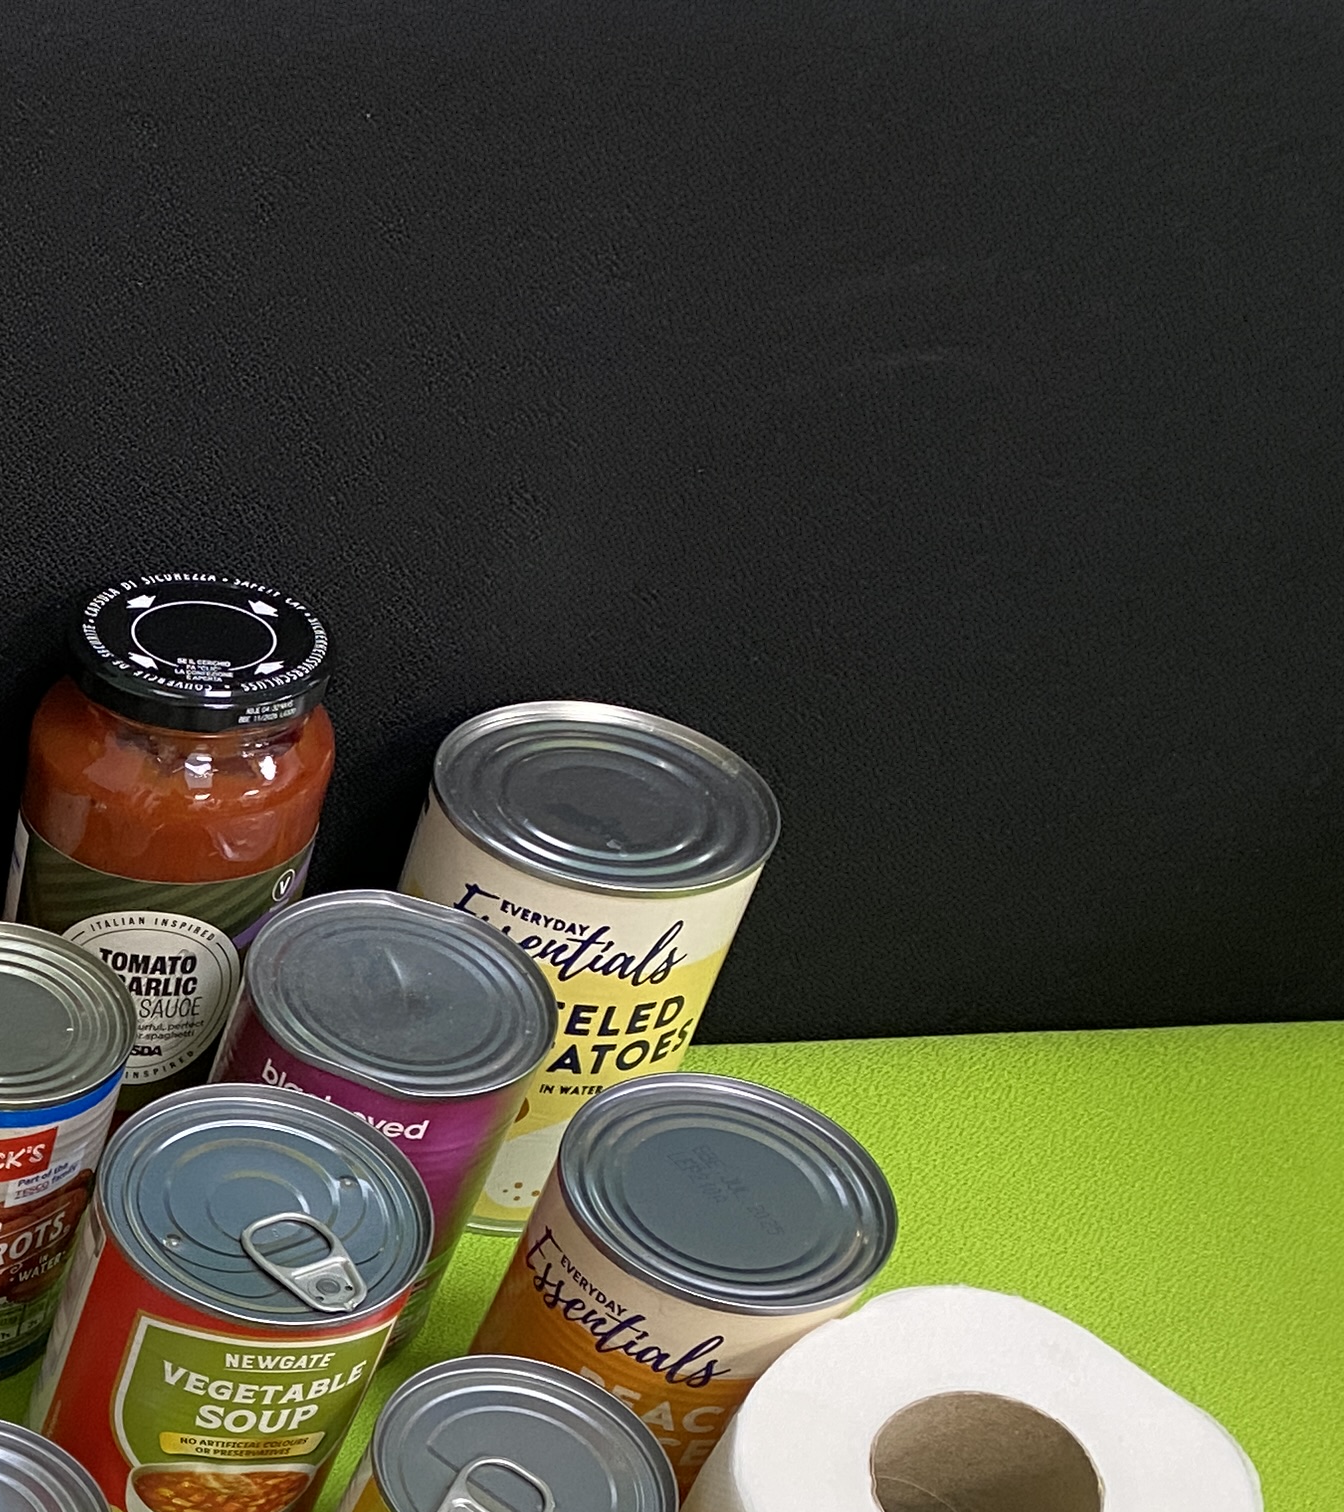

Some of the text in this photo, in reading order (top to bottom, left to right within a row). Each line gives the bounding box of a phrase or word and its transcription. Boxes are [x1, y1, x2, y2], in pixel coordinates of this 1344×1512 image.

[89, 917, 216, 942] ITALIAN INSPIRED
[500, 900, 590, 937] EVERYDAY
[100, 948, 197, 976] TOMATO
[139, 997, 202, 1018] SAUCE
[559, 1084, 603, 1096] WATER
[559, 1254, 628, 1316] EVERYDAY
[525, 1226, 732, 1389] Essentials
[224, 1352, 336, 1370] NEWGATE
[162, 1359, 368, 1405] VEGETABLE
[195, 1404, 319, 1434] SOUP
[180, 1437, 197, 1446] NO
